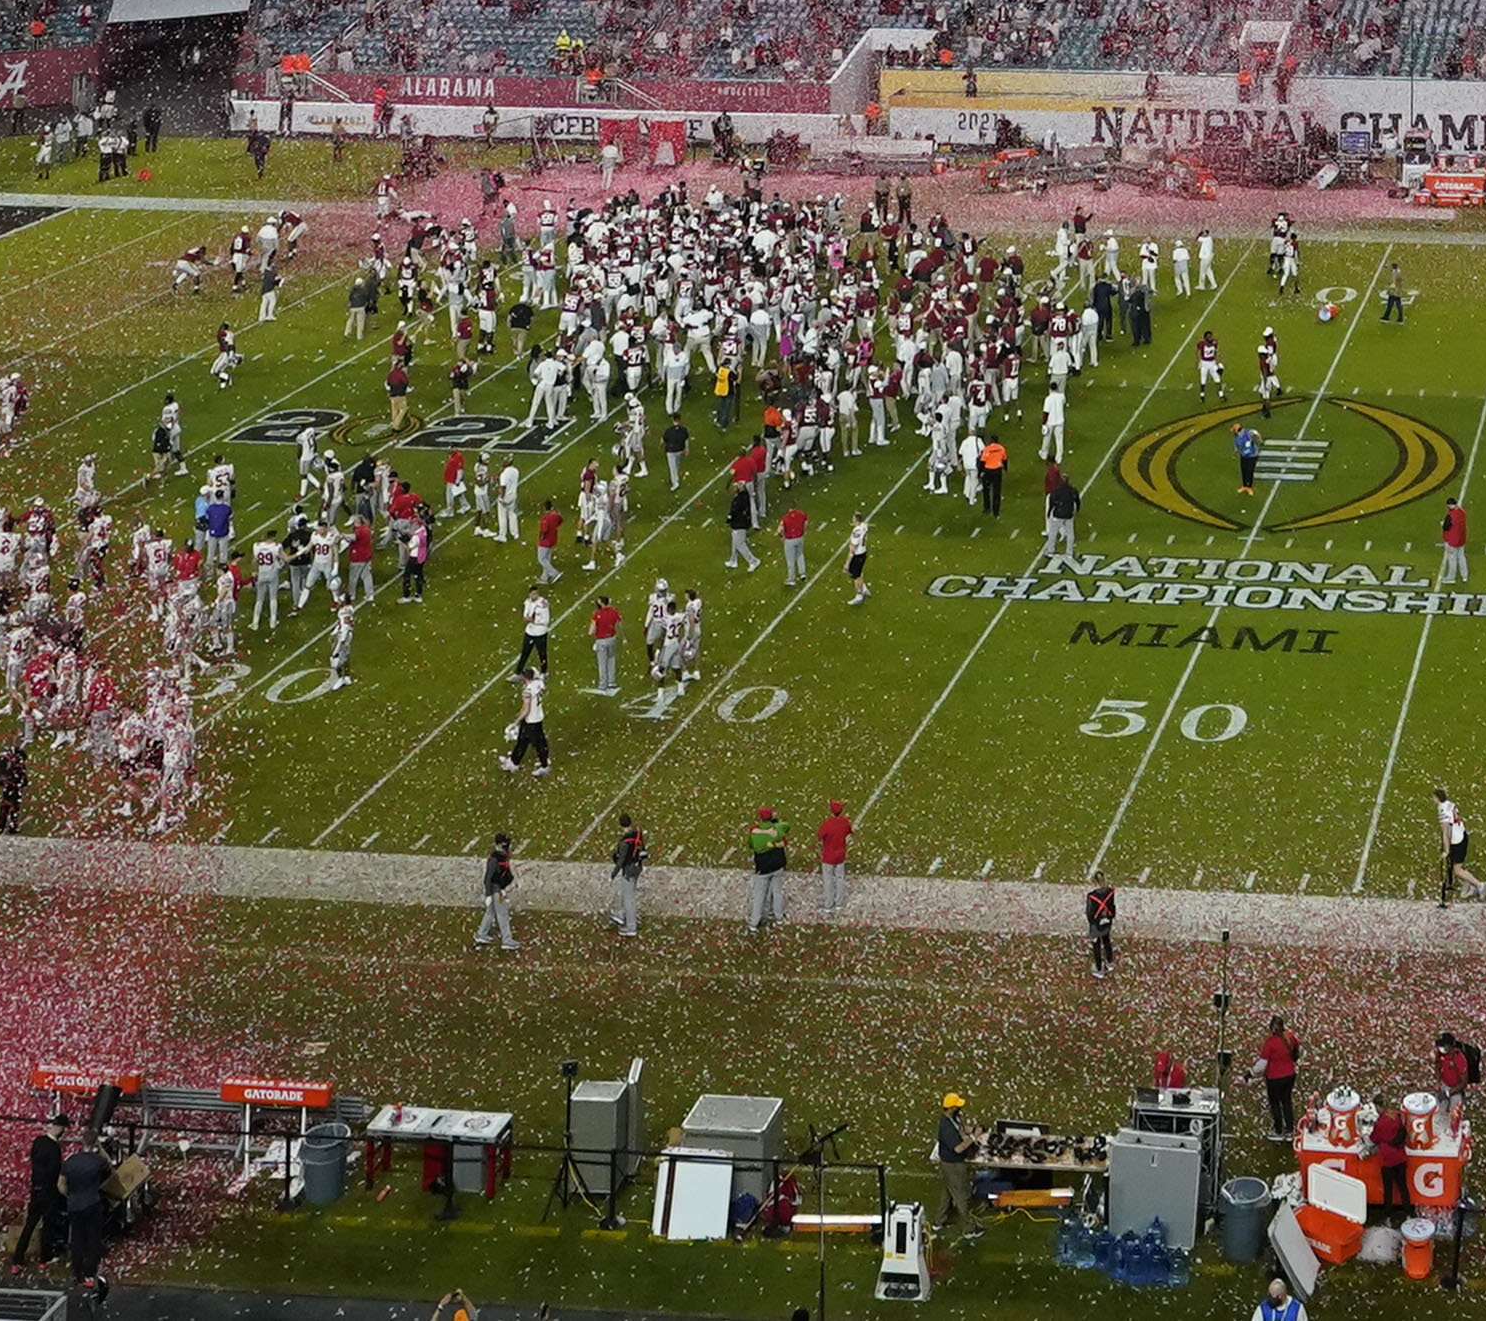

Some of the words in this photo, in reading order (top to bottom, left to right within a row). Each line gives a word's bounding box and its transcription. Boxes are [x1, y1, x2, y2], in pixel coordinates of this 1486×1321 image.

[401, 76, 496, 99] ALABAMA
[1036, 554, 1433, 589] NATIONAL
[1067, 620, 1339, 654] MIAMI
[1077, 699, 1249, 743] 50
[243, 1087, 304, 1103] GATORADE
[1414, 1162, 1445, 1198] G
